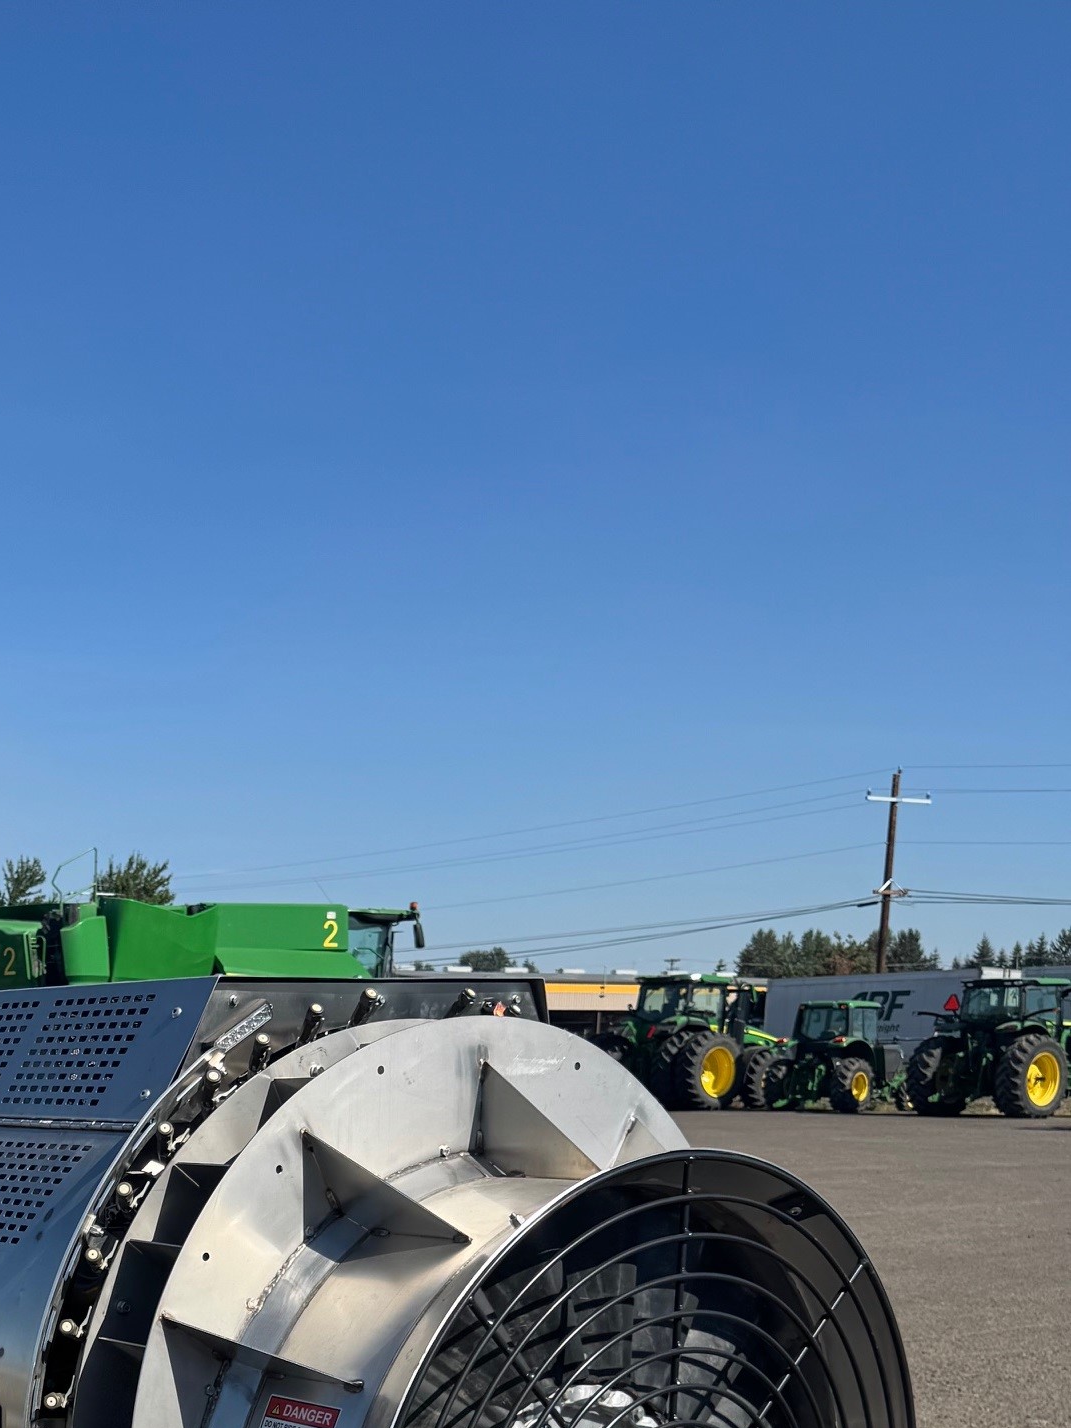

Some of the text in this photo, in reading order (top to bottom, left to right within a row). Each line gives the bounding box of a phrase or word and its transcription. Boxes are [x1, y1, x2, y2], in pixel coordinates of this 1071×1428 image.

[323, 920, 338, 948] 2
[3, 947, 16, 975] 2
[264, 1420, 272, 1428] DO
[282, 1404, 333, 1426] DANGER
